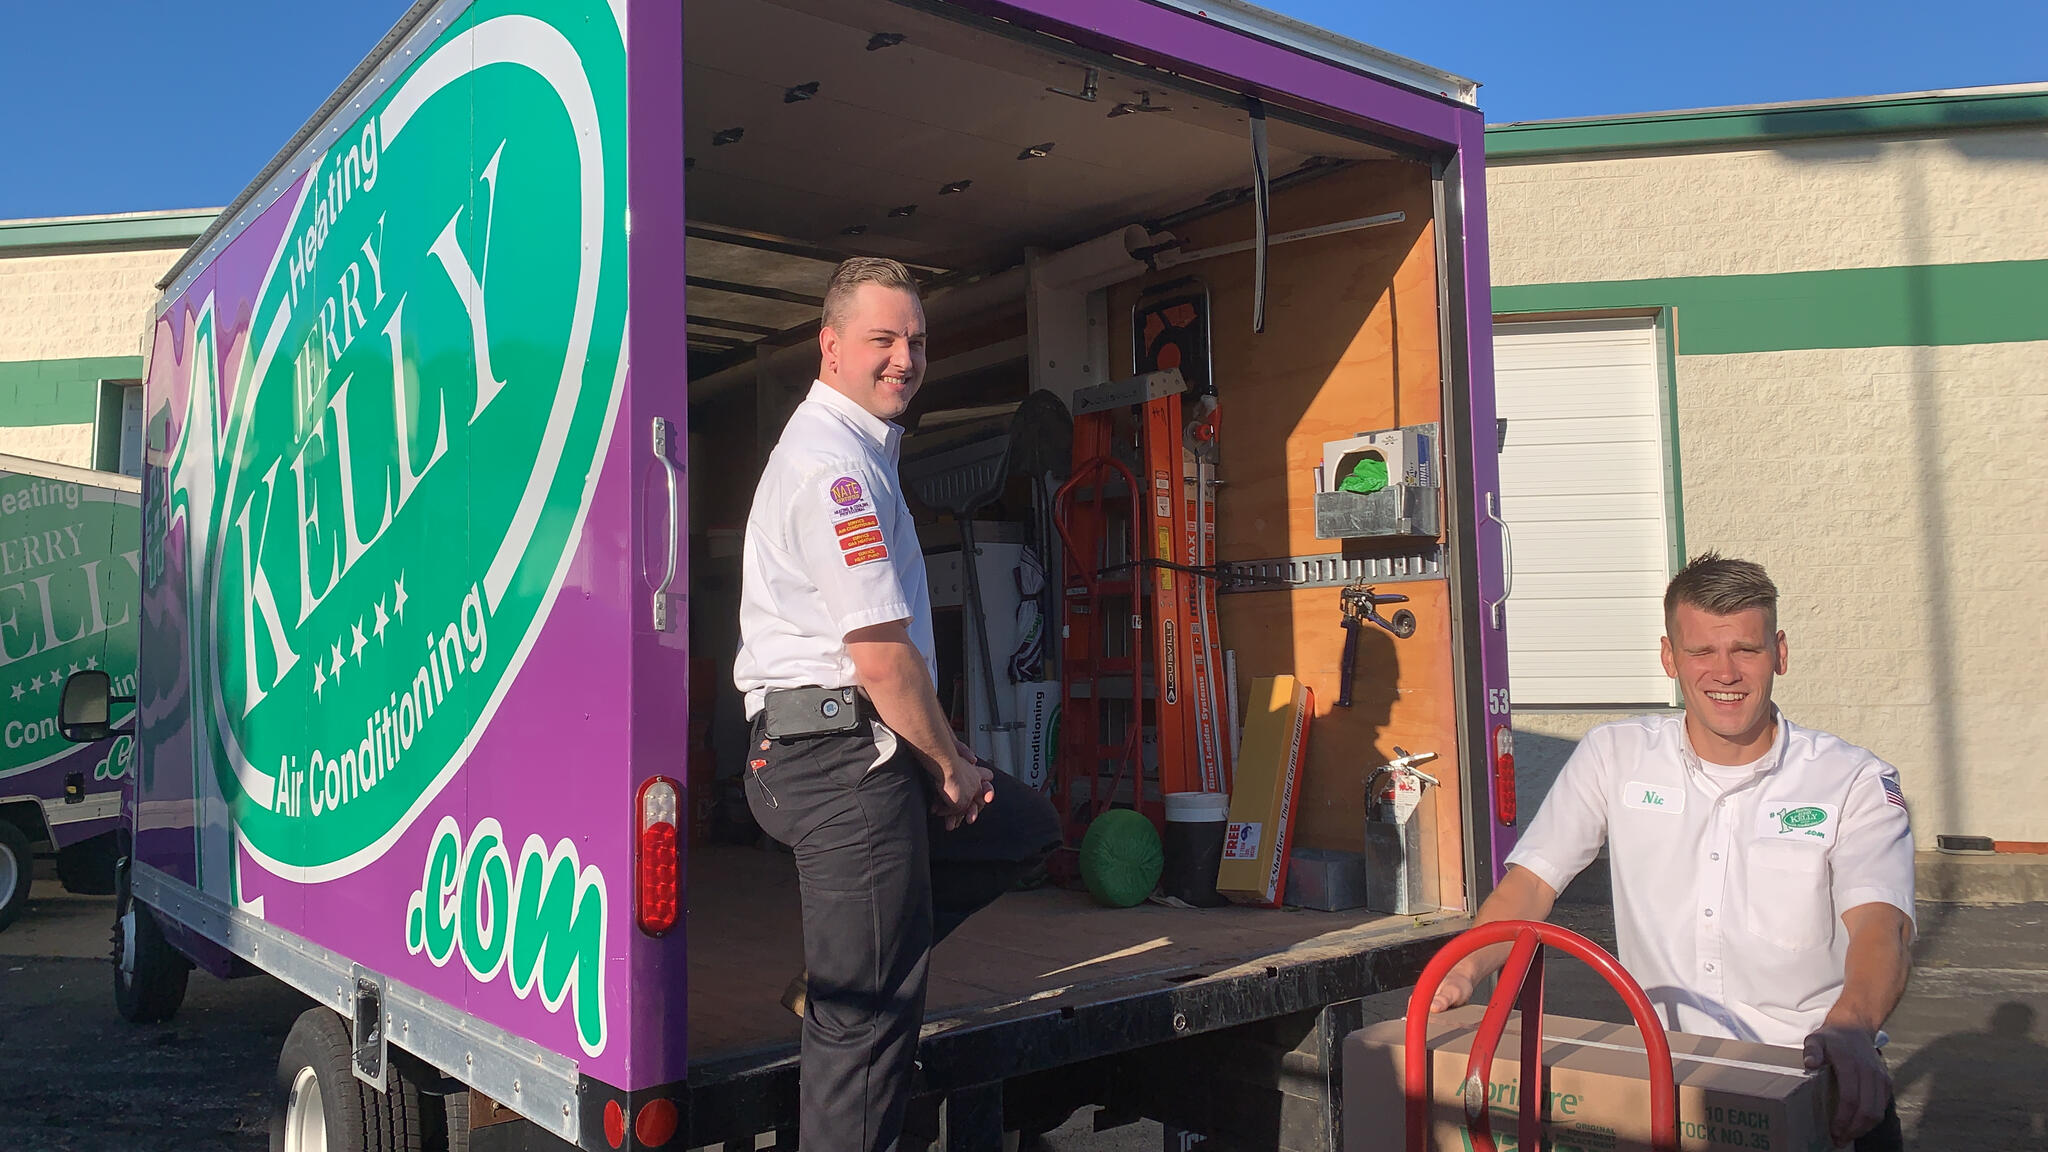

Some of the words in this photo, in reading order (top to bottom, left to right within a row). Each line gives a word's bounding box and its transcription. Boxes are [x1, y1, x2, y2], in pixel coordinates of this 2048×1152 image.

[288, 116, 379, 309] Heating
[293, 210, 387, 444] JERRY
[236, 138, 507, 720] KELLY
[0, 480, 79, 516] eating
[831, 482, 859, 502] NATE
[0, 523, 84, 575] ERRY
[0, 550, 140, 666] ELL
[1165, 622, 1175, 690] LOUISVILLE
[275, 755, 304, 818] Air
[309, 580, 488, 817] Conditioning
[1489, 688, 1510, 715] 53
[1030, 691, 1045, 780] Conditioning
[1292, 702, 1305, 748] Treatment
[1287, 748, 1298, 781] Carpet
[1284, 782, 1293, 801] Red
[1641, 790, 1664, 806] Nic
[1281, 803, 1290, 821] The
[1225, 824, 1240, 857] FREE
[1805, 830, 1825, 838] .com
[406, 816, 608, 1058] .com
[1680, 1121, 1718, 1141] TOCK
[1705, 1107, 1723, 1123] 10
[1727, 1108, 1770, 1130] EACH
